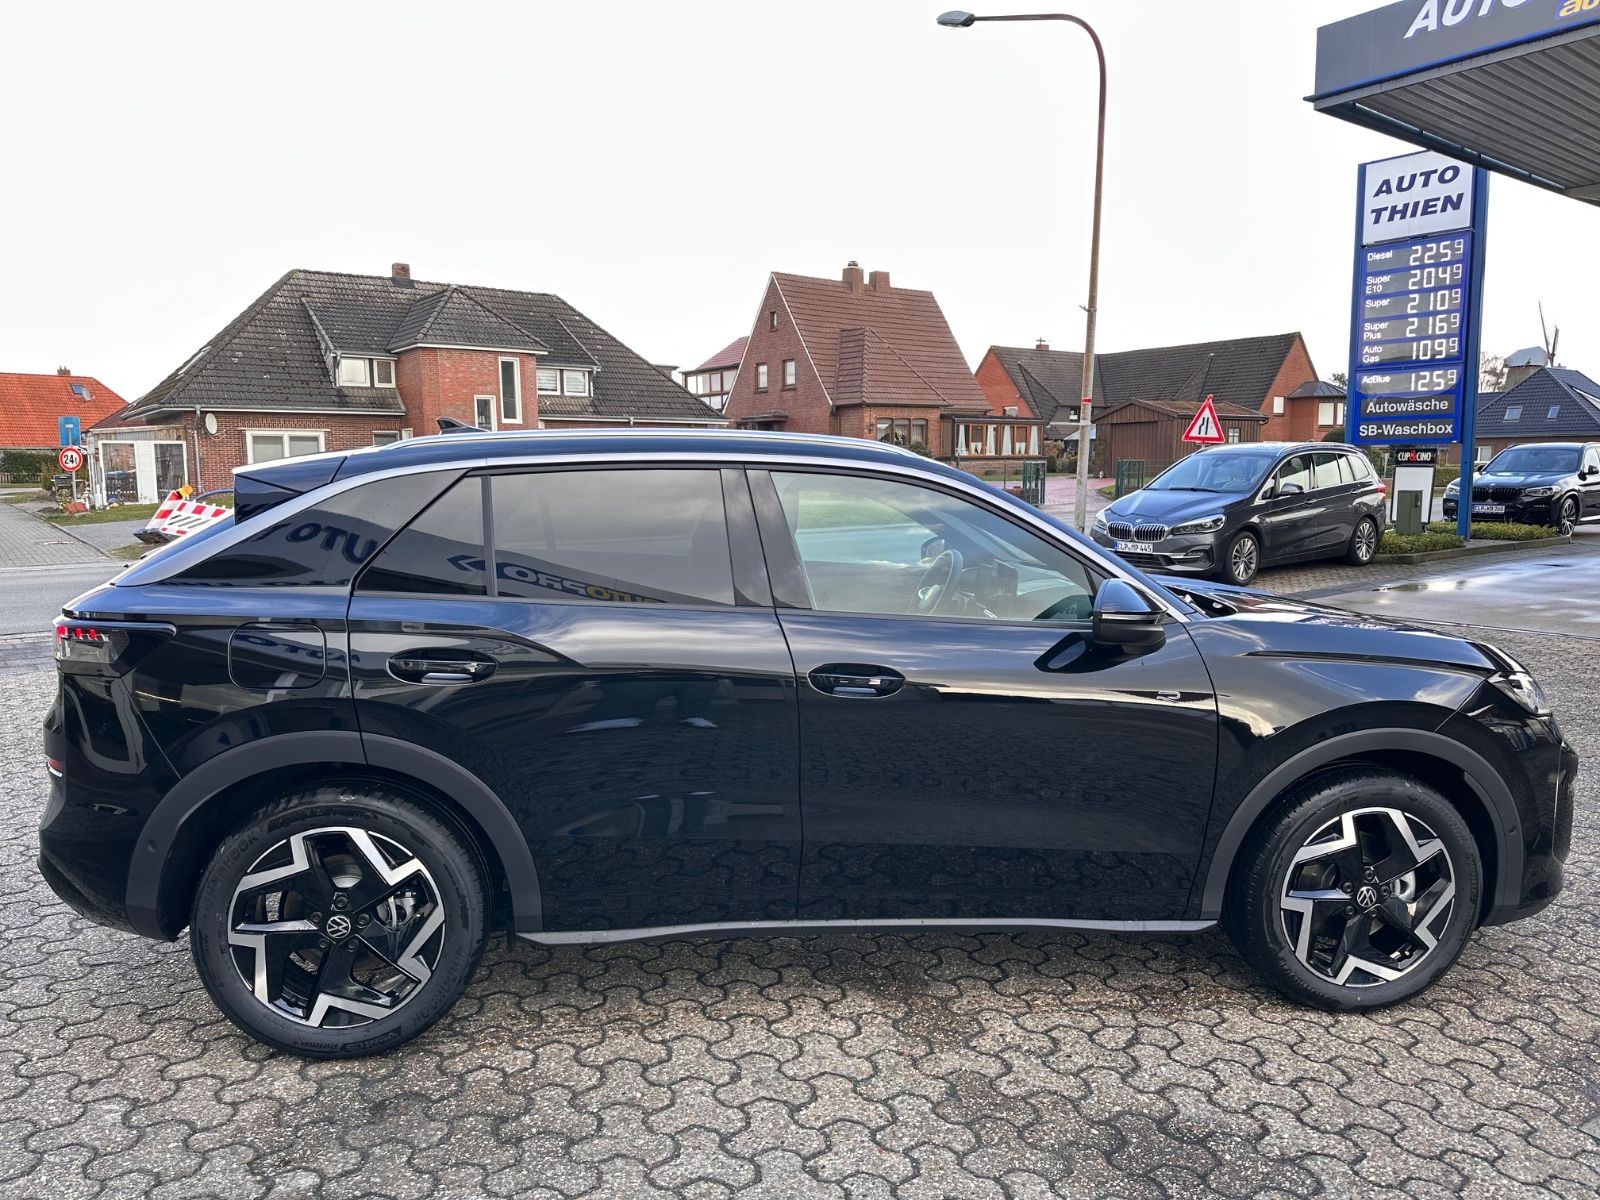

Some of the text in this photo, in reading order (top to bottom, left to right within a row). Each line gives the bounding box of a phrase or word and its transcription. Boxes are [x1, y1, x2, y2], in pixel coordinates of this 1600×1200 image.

[1403, 0, 1528, 38] AU
[1372, 165, 1460, 197] AUTO
[1370, 192, 1464, 225] THIEN
[1367, 250, 1393, 261] Diesel
[1366, 275, 1391, 288] Super
[1365, 285, 1383, 294] E10
[1364, 298, 1391, 308] Super
[1364, 322, 1389, 331] Super
[1363, 332, 1382, 340] Plus
[1362, 345, 1382, 354] Auto
[1362, 355, 1380, 363] Gas
[1362, 375, 1390, 384] AdBlue
[1366, 399, 1449, 413] Autowäsche
[1359, 423, 1453, 437] SB-Waschbox
